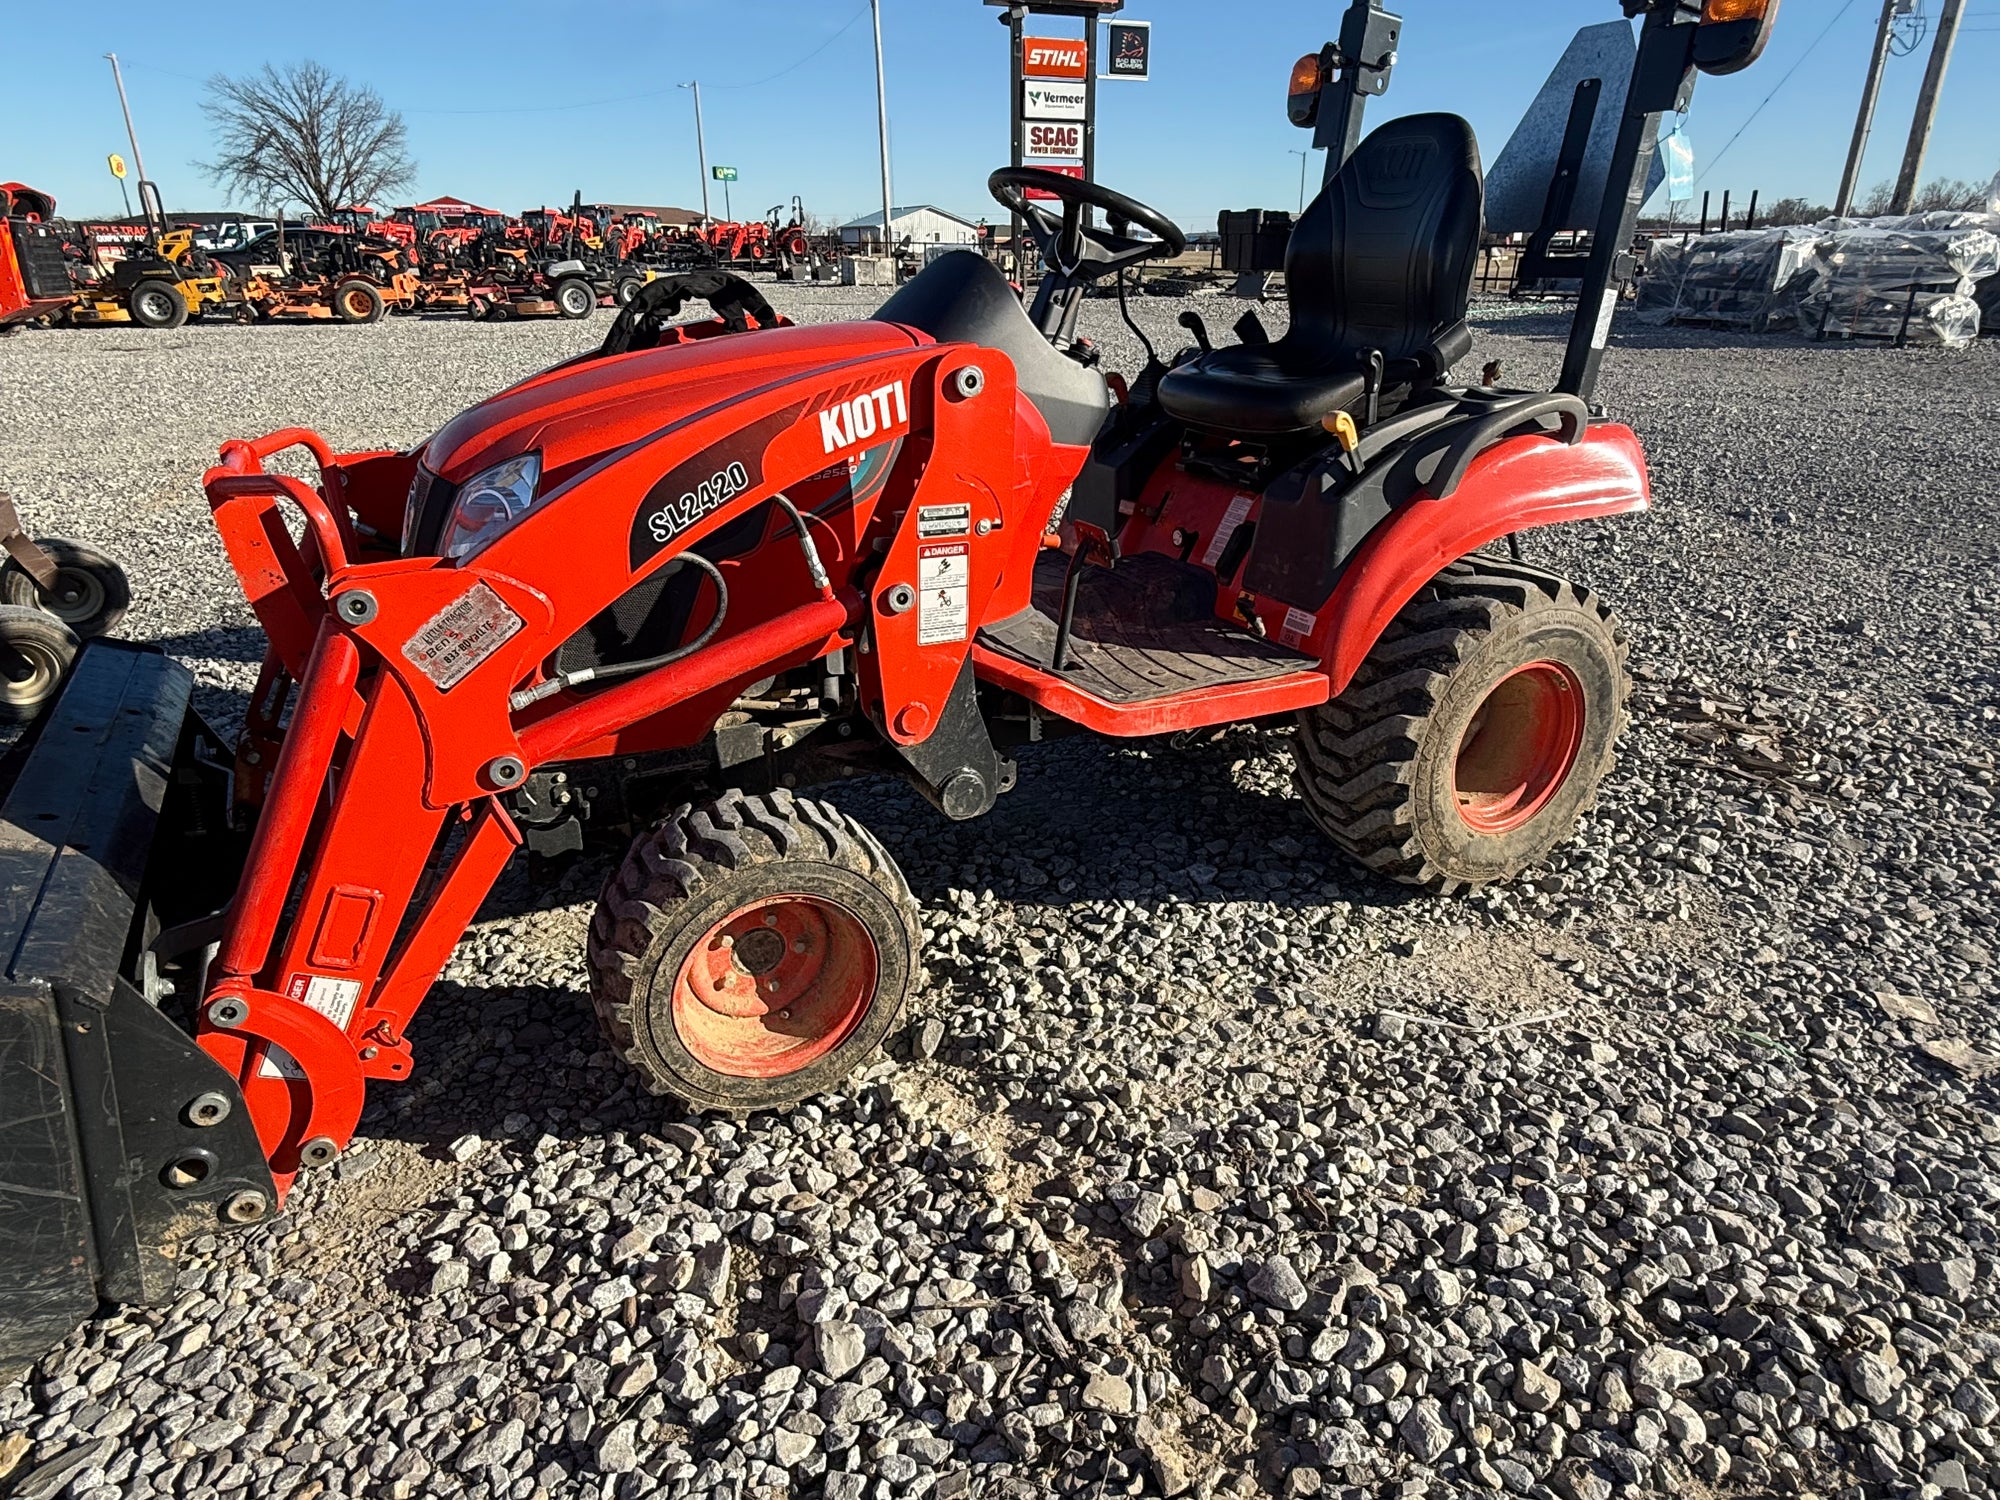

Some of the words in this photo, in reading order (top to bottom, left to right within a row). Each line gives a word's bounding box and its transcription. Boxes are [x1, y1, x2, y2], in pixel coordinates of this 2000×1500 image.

[1028, 48, 1082, 67] STIHL
[1043, 91, 1085, 104] Vermeer
[1030, 126, 1078, 146] SCAG
[1031, 146, 1048, 154] POWER
[116, 162, 123, 173] 8
[819, 380, 908, 455] KIOTI
[648, 461, 749, 543] SL2420
[931, 545, 965, 556] DANGER
[441, 601, 473, 629] TRACTOR
[291, 979, 306, 999] GER
